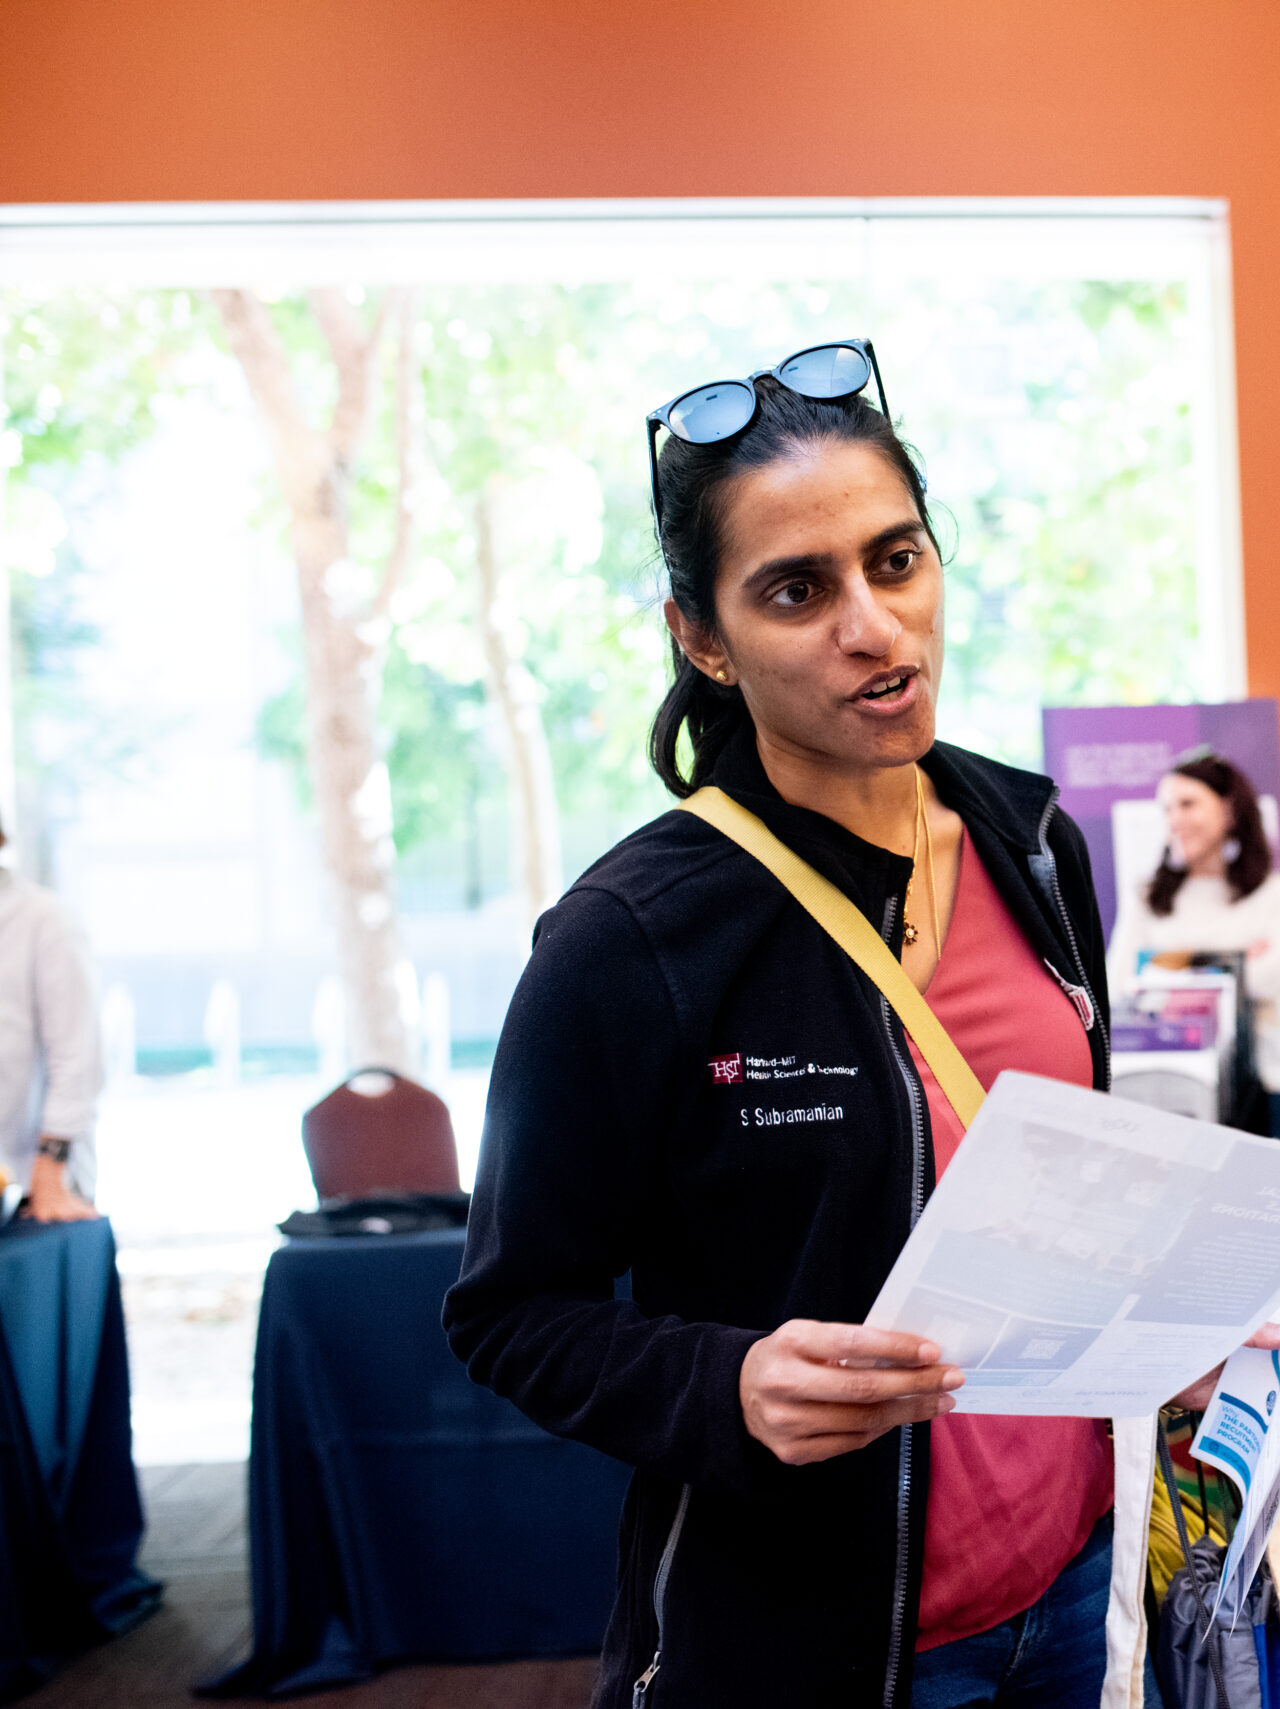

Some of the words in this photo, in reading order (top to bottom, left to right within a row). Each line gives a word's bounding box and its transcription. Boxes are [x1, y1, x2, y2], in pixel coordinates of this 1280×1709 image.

[708, 1053, 740, 1084] HST
[807, 1062, 816, 1074] &
[741, 1108, 750, 1127] S
[755, 1103, 844, 1126] Subramanian
[1224, 1413, 1238, 1426] THE
